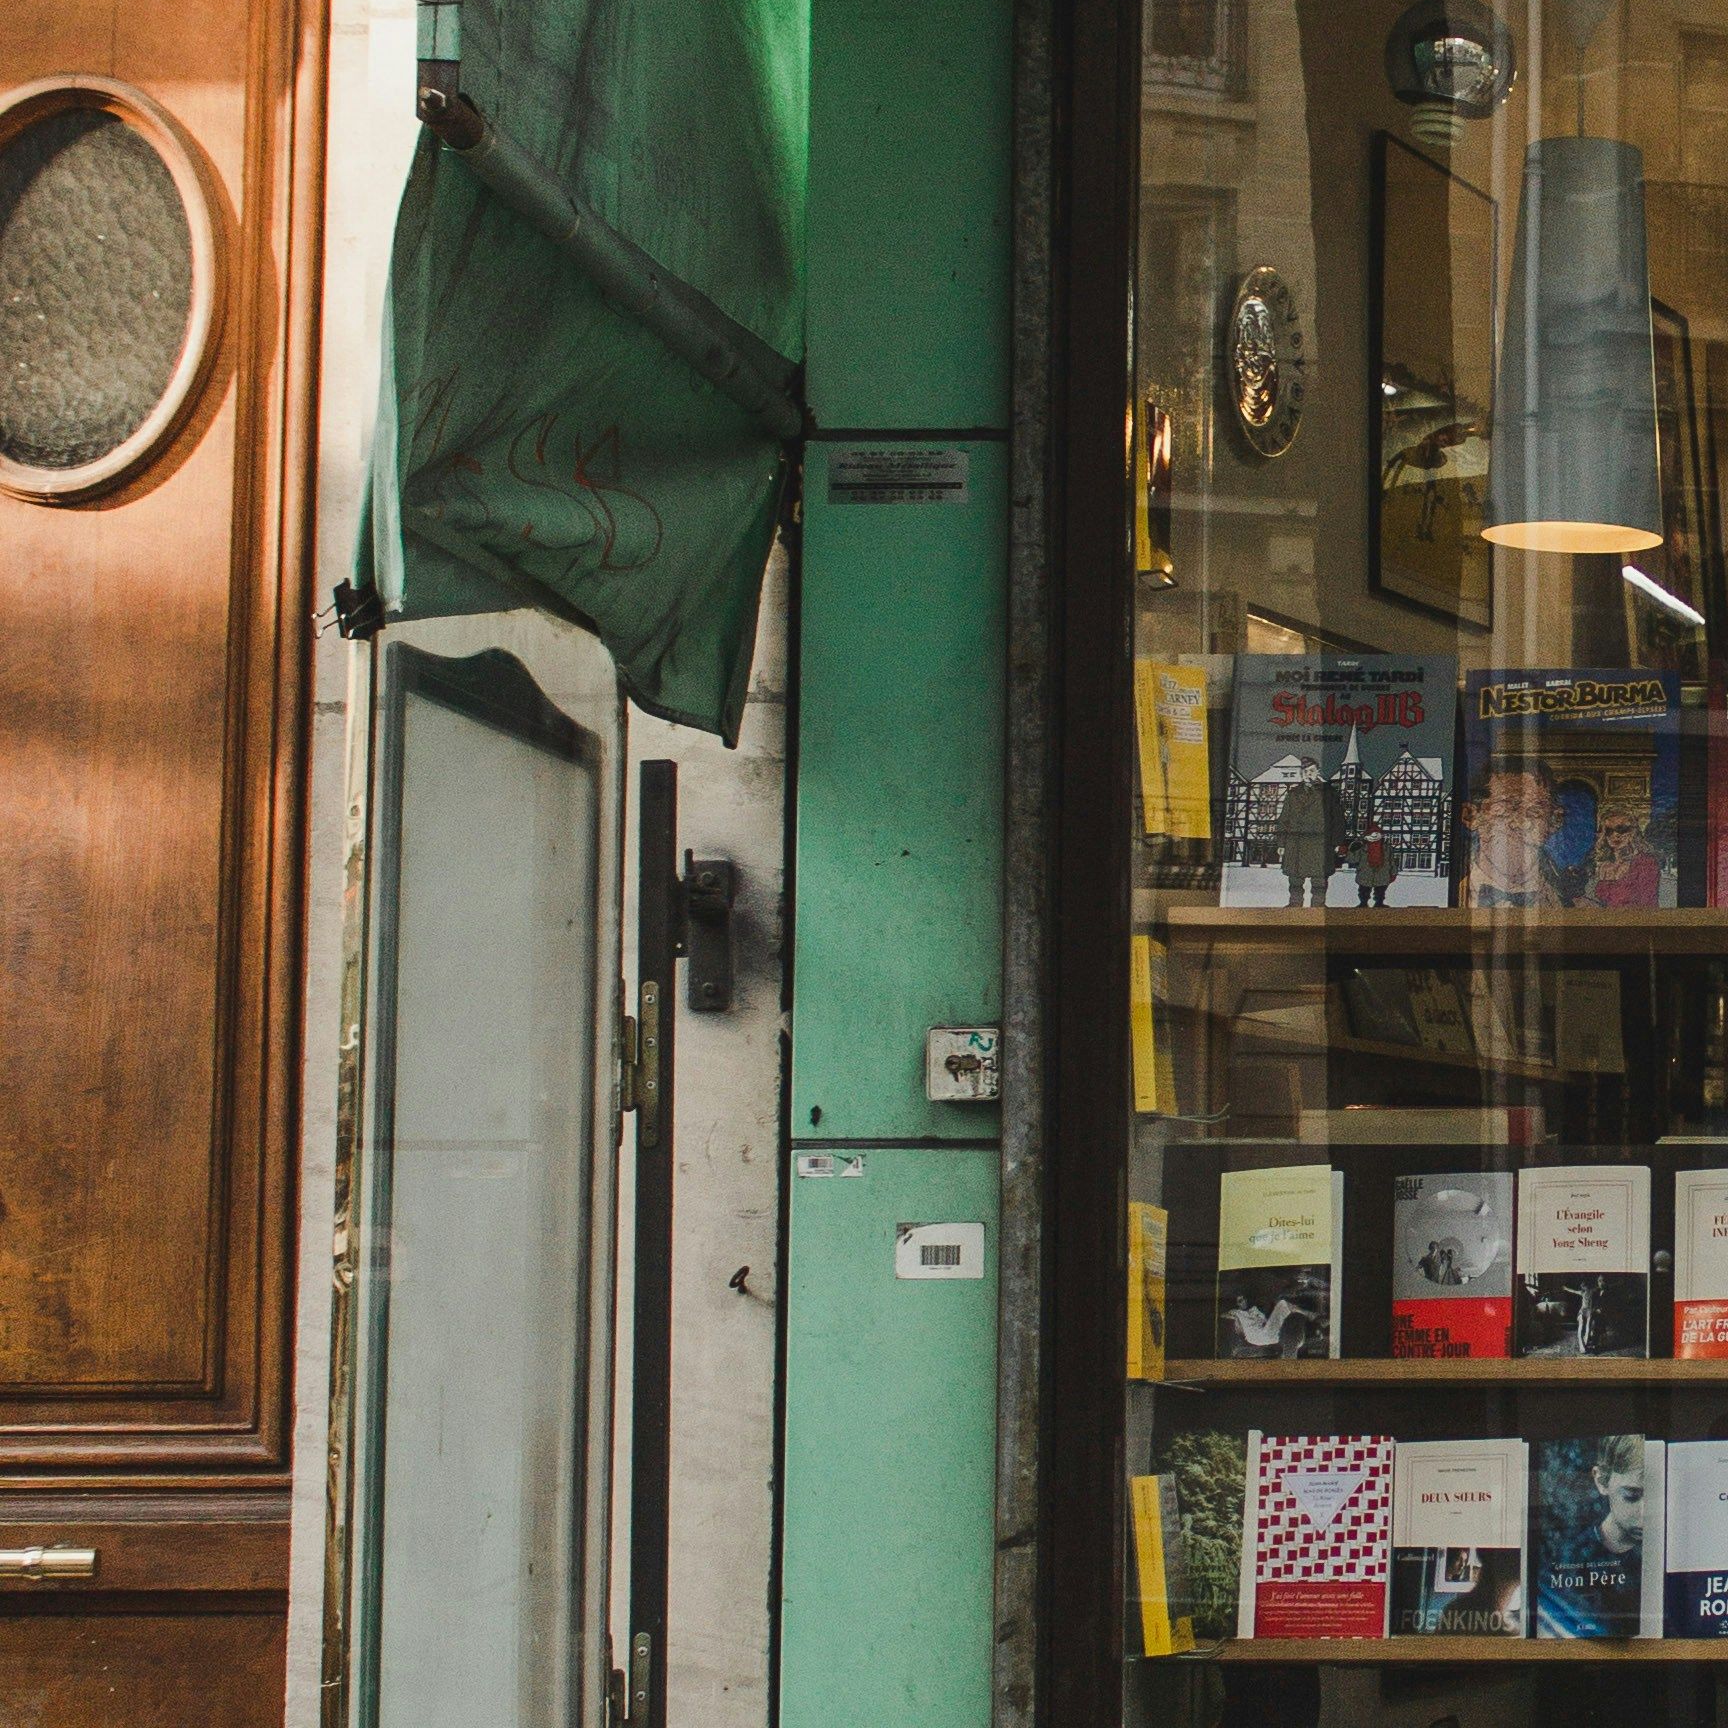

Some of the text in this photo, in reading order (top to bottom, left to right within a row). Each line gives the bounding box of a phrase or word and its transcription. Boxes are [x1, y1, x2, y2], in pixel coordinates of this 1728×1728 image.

[1370, 667, 1424, 683] TARDI
[1479, 679, 1667, 719] NESTOR BURMA
[1269, 1214, 1315, 1228] Dites-lui
[1556, 1207, 1605, 1222] L'Évangile
[1282, 1228, 1315, 1240] l'aime
[1567, 1223, 1592, 1234] selon
[1683, 1319, 1714, 1332] L'ART
[1681, 1331, 1698, 1344] DE
[1700, 1331, 1715, 1343] LA
[1421, 1491, 1492, 1504] DEUX SŒURS
[1550, 1570, 1627, 1589] Mon Père
[1401, 1608, 1516, 1632] FOENKINOS
